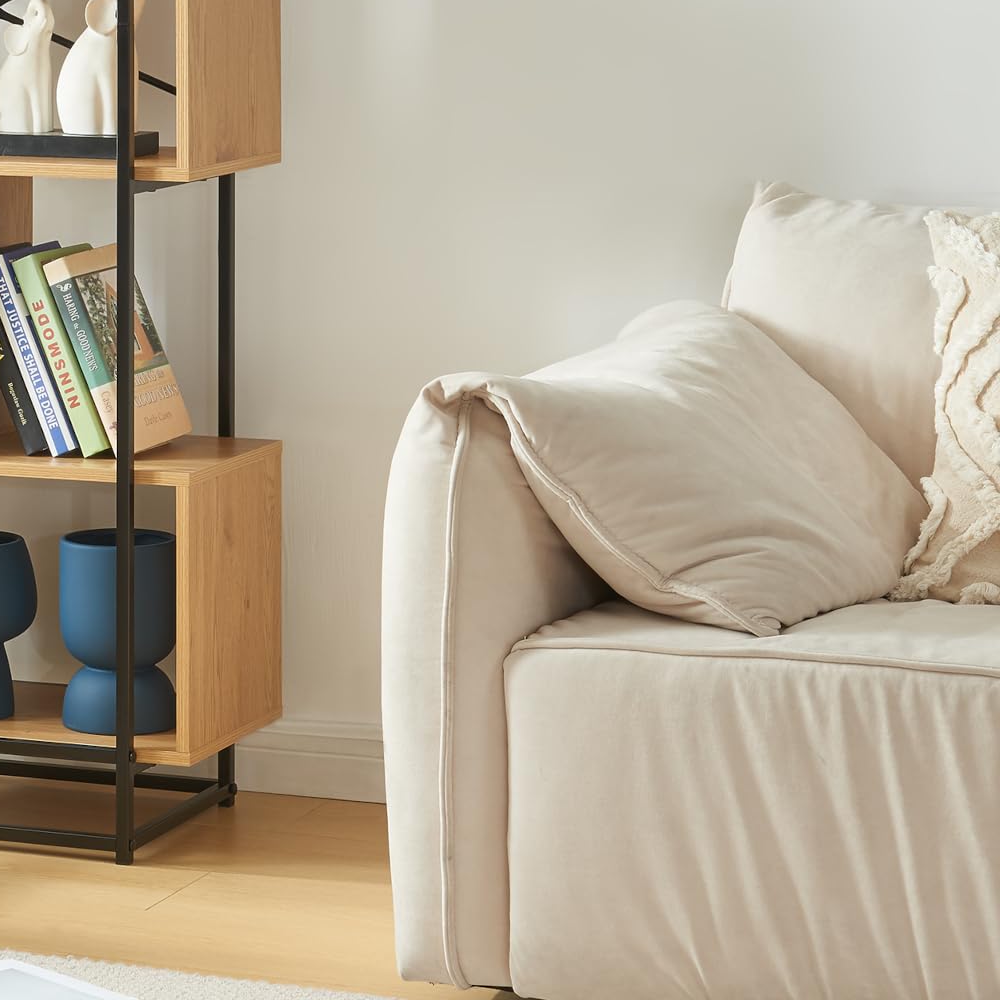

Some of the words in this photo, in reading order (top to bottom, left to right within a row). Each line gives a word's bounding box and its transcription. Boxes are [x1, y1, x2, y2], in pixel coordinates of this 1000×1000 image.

[7, 309, 29, 352] JUSTICE
[23, 353, 42, 386] SHALL
[31, 299, 81, 409] NINSMODE
[35, 386, 48, 399] BE
[40, 400, 59, 430] DONE
